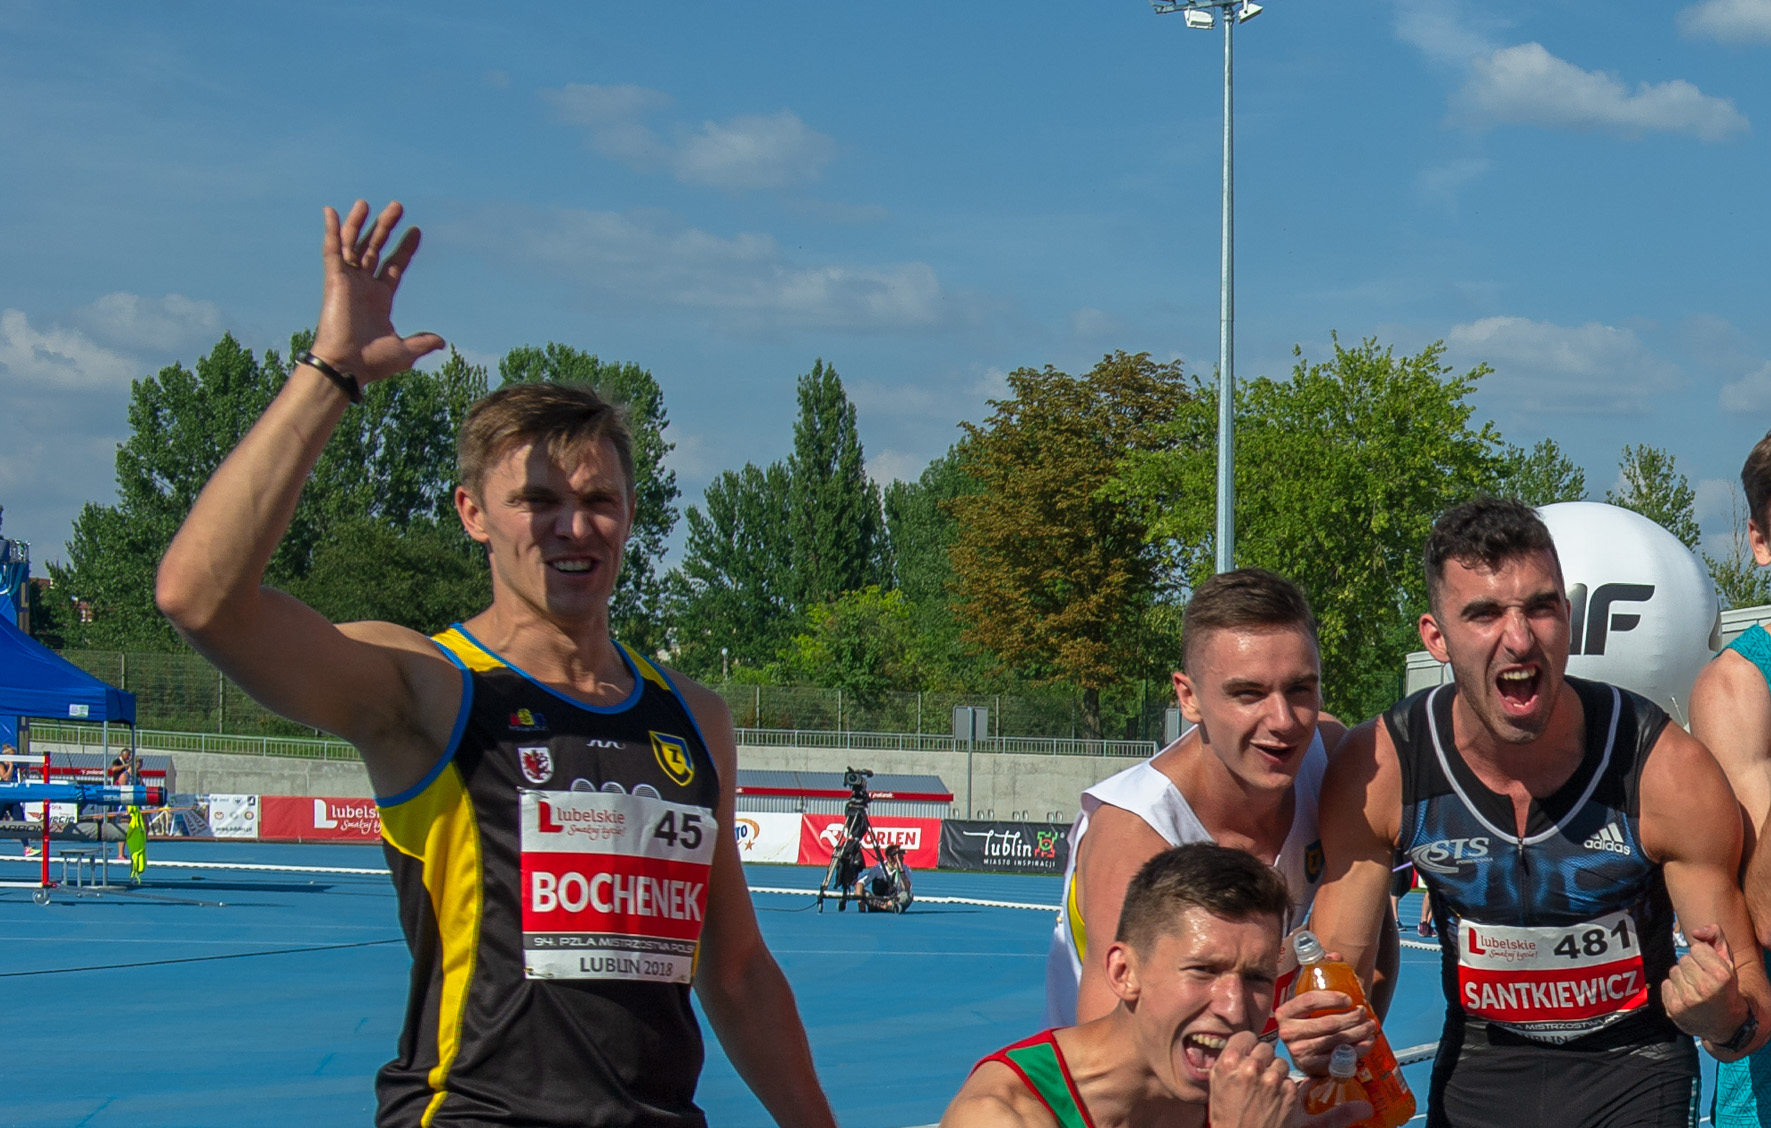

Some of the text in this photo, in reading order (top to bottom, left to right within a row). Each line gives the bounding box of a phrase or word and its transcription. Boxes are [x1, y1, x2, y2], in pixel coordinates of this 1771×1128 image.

[556, 807, 626, 825] lubelskie
[653, 809, 703, 850] 45
[864, 831, 917, 846] ORLEN
[1429, 836, 1490, 862] STS
[1584, 838, 1631, 856] adidas
[983, 858, 1056, 869] MIASTO INSPIRACJI
[531, 870, 705, 923] BOCHENEK
[533, 936, 557, 947] 94.
[559, 937, 595, 947] PZLA
[597, 937, 671, 951] MISTRZOSTWA
[1480, 934, 1537, 951] lubelskie
[1553, 919, 1634, 960] 481
[579, 956, 674, 977] LUBLIN 2018
[1465, 970, 1640, 1011] SANTKIEWICZ
